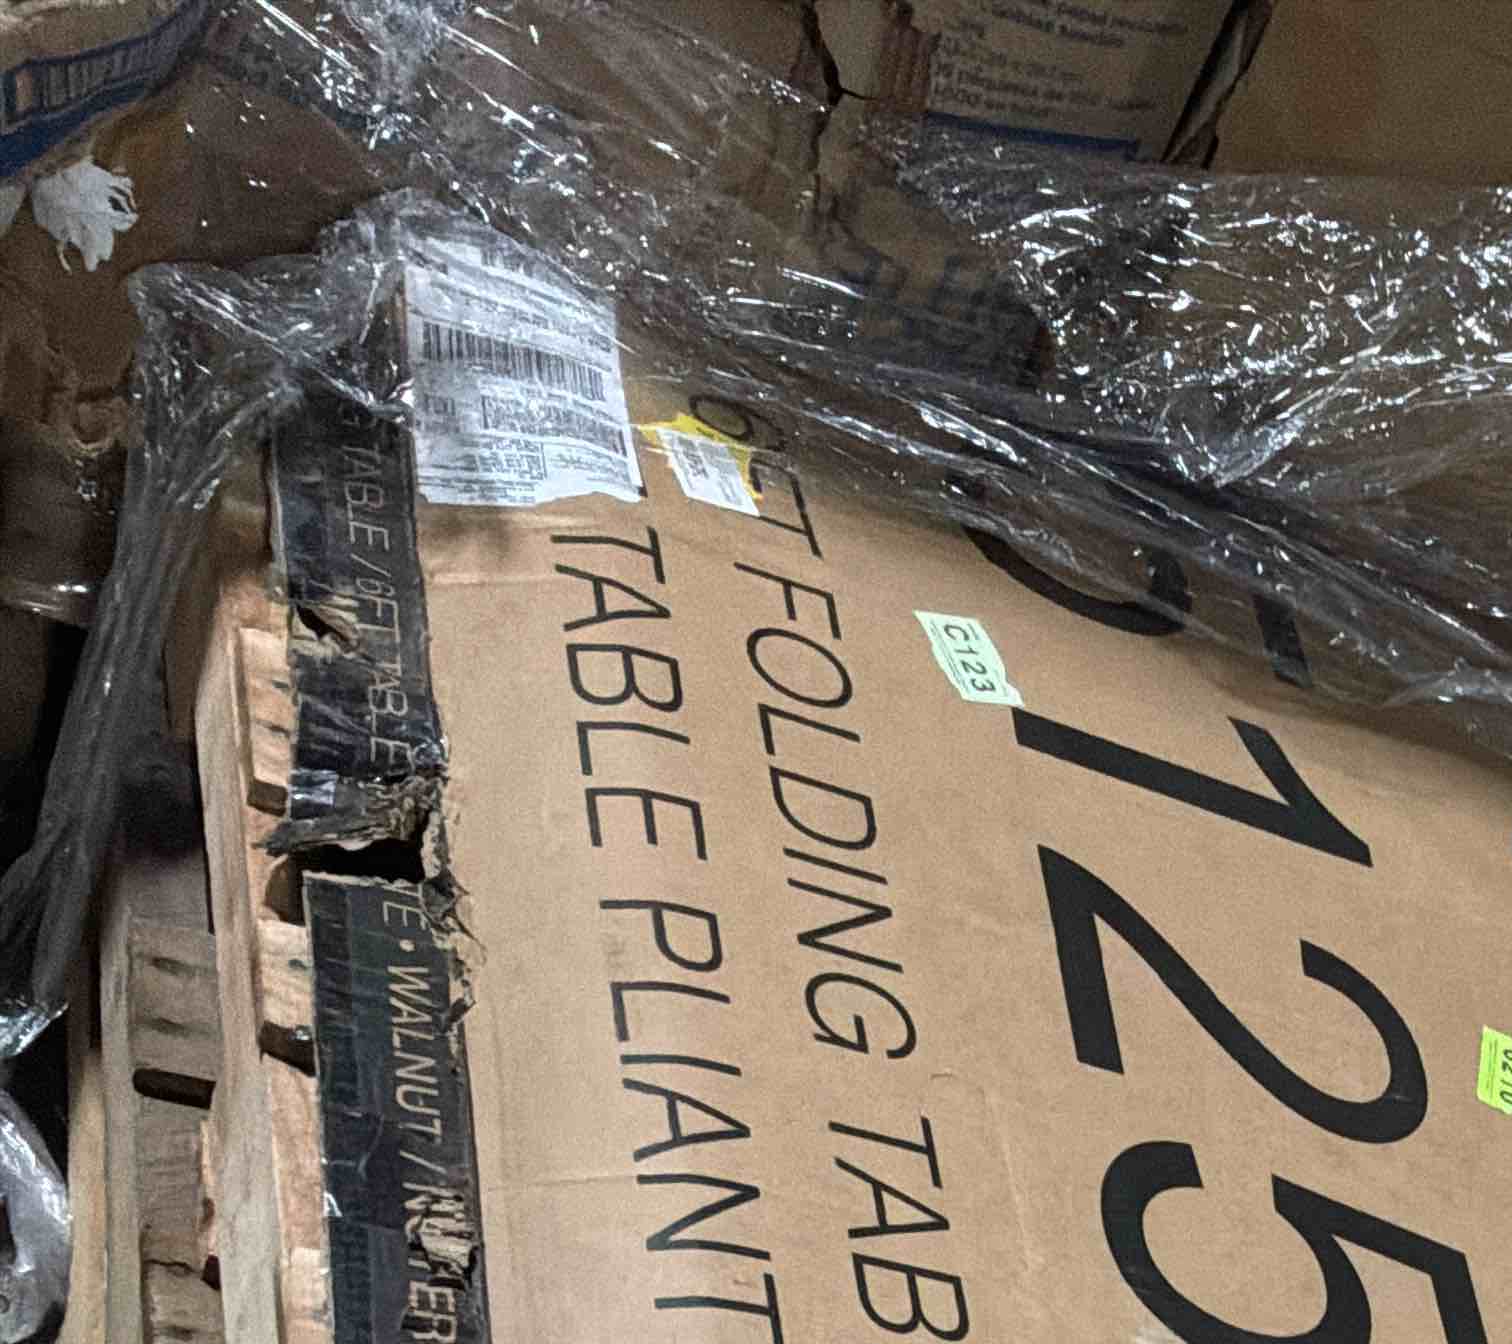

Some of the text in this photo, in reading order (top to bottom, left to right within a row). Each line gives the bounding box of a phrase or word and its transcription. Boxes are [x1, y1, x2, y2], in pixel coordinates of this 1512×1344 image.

[550, 526, 708, 860] TABLE
[940, 622, 995, 695] C123
[733, 559, 917, 1060] FOLDING
[385, 963, 442, 1139] WALNUT
